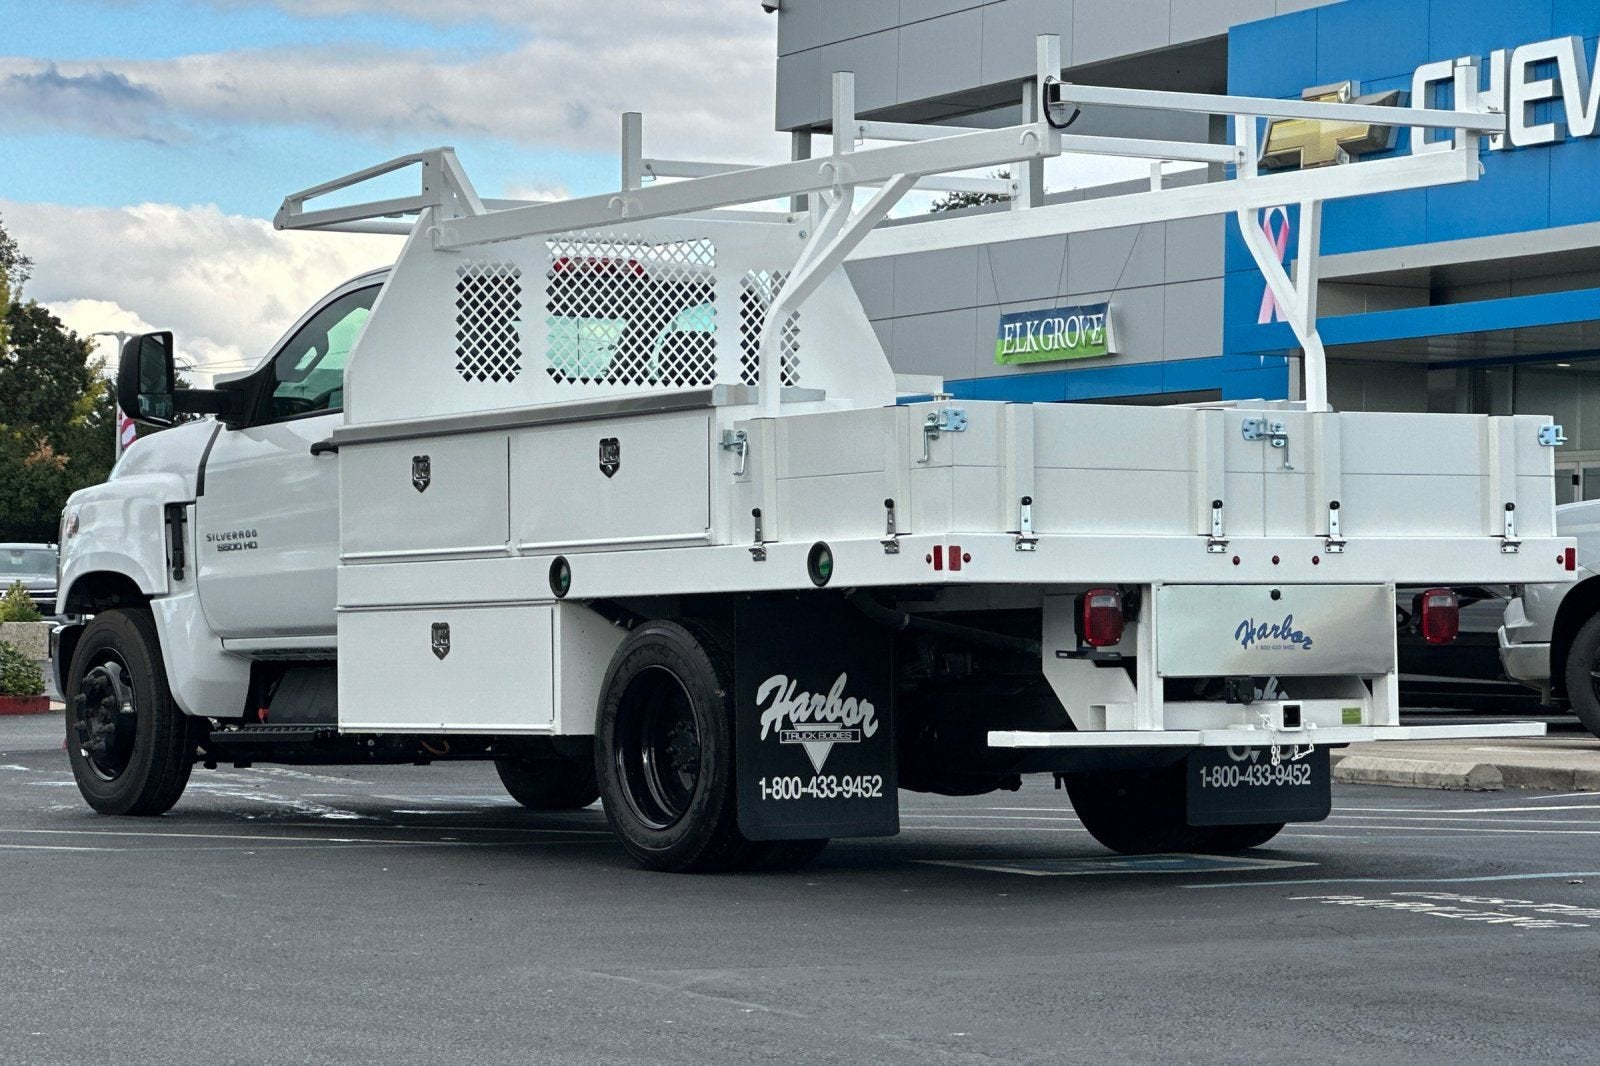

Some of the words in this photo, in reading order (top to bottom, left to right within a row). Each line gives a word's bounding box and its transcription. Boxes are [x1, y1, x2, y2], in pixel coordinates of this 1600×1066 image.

[206, 529, 257, 542] SILVERADO
[217, 542, 242, 552] 5500
[243, 541, 258, 550] HD
[1234, 614, 1313, 650] Harbor
[756, 672, 879, 741] Harbor
[785, 731, 817, 740] TRUCK
[759, 775, 883, 800] 1-800-433-9452
[1200, 763, 1311, 788] 1-800-433-9452
